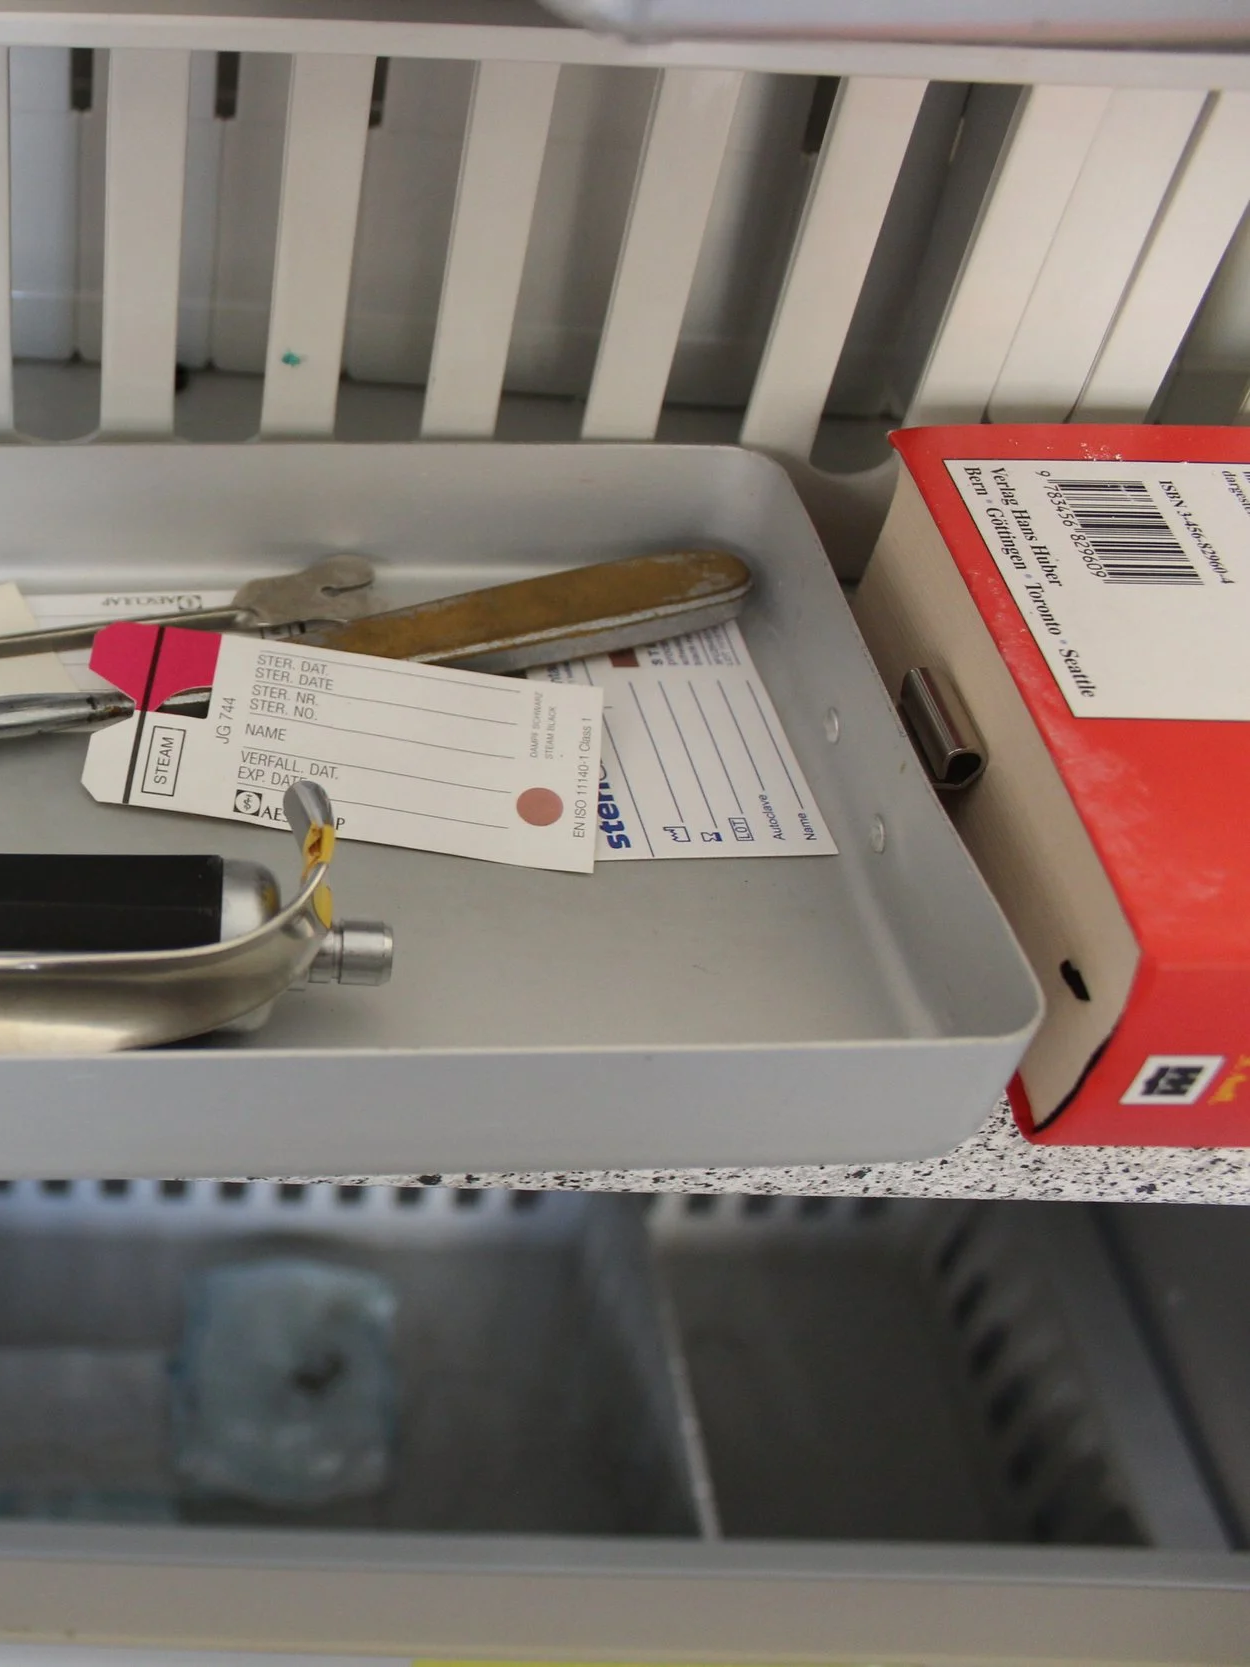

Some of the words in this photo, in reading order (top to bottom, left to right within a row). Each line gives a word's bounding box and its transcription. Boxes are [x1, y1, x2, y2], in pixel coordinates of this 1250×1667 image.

[990, 467, 1019, 506] Verlag
[1011, 509, 1038, 541] Hans
[1030, 545, 1063, 587] Huber
[1043, 485, 1078, 527] 783456
[1070, 534, 1107, 578] 829609
[1158, 480, 1188, 508] ISBN
[1177, 511, 1236, 584] 3-456-82960-4
[963, 467, 988, 496] Bern
[986, 507, 1027, 570] Göttingen
[1025, 582, 1062, 636] Toronto
[1059, 649, 1096, 697] Seattle
[256, 654, 295, 670] STER.
[300, 660, 329, 676] DAT.
[254, 667, 293, 684] STER.
[298, 674, 334, 691] DATE
[252, 684, 291, 701] STER.
[296, 691, 319, 706] NR.
[218, 697, 236, 720] 744
[249, 697, 289, 716] STER.
[294, 705, 318, 720] NO.
[215, 725, 231, 745] JG
[245, 723, 287, 742] NAME
[579, 726, 592, 751] Class
[153, 736, 175, 785] STEAM
[240, 750, 304, 774] VERFALL.
[309, 763, 339, 780] DAT.
[237, 766, 266, 782] EXP.
[576, 754, 590, 795] 11140-1
[574, 799, 587, 821] ISO
[758, 794, 786, 840] Autoclave
[573, 823, 586, 838] EN
[731, 820, 750, 839] LOT
[798, 812, 817, 840] Name
